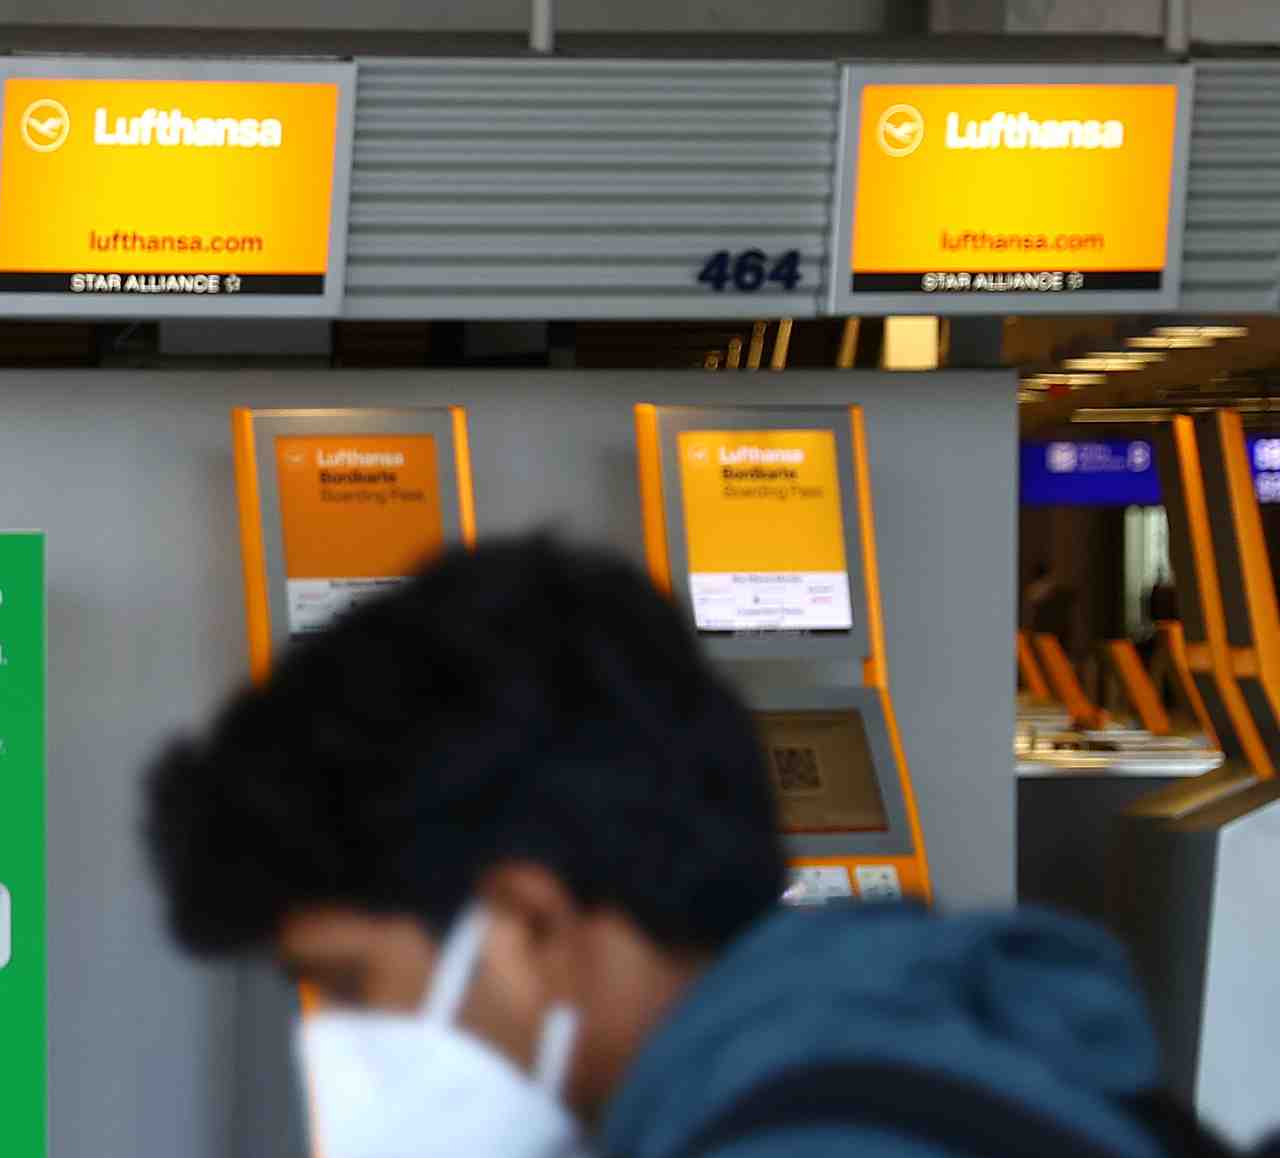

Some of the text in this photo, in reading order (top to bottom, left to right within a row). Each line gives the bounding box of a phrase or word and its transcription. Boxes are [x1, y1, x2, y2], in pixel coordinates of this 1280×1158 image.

[93, 107, 283, 148] Lufthansa
[945, 111, 1125, 150] Lufthansa
[88, 229, 264, 254] lufthansa.com
[941, 229, 1105, 252] lufthansa.com
[69, 274, 221, 294] STAR ALLIANCE
[697, 250, 801, 293] 464
[920, 271, 1064, 292] STAR ALLIANCE
